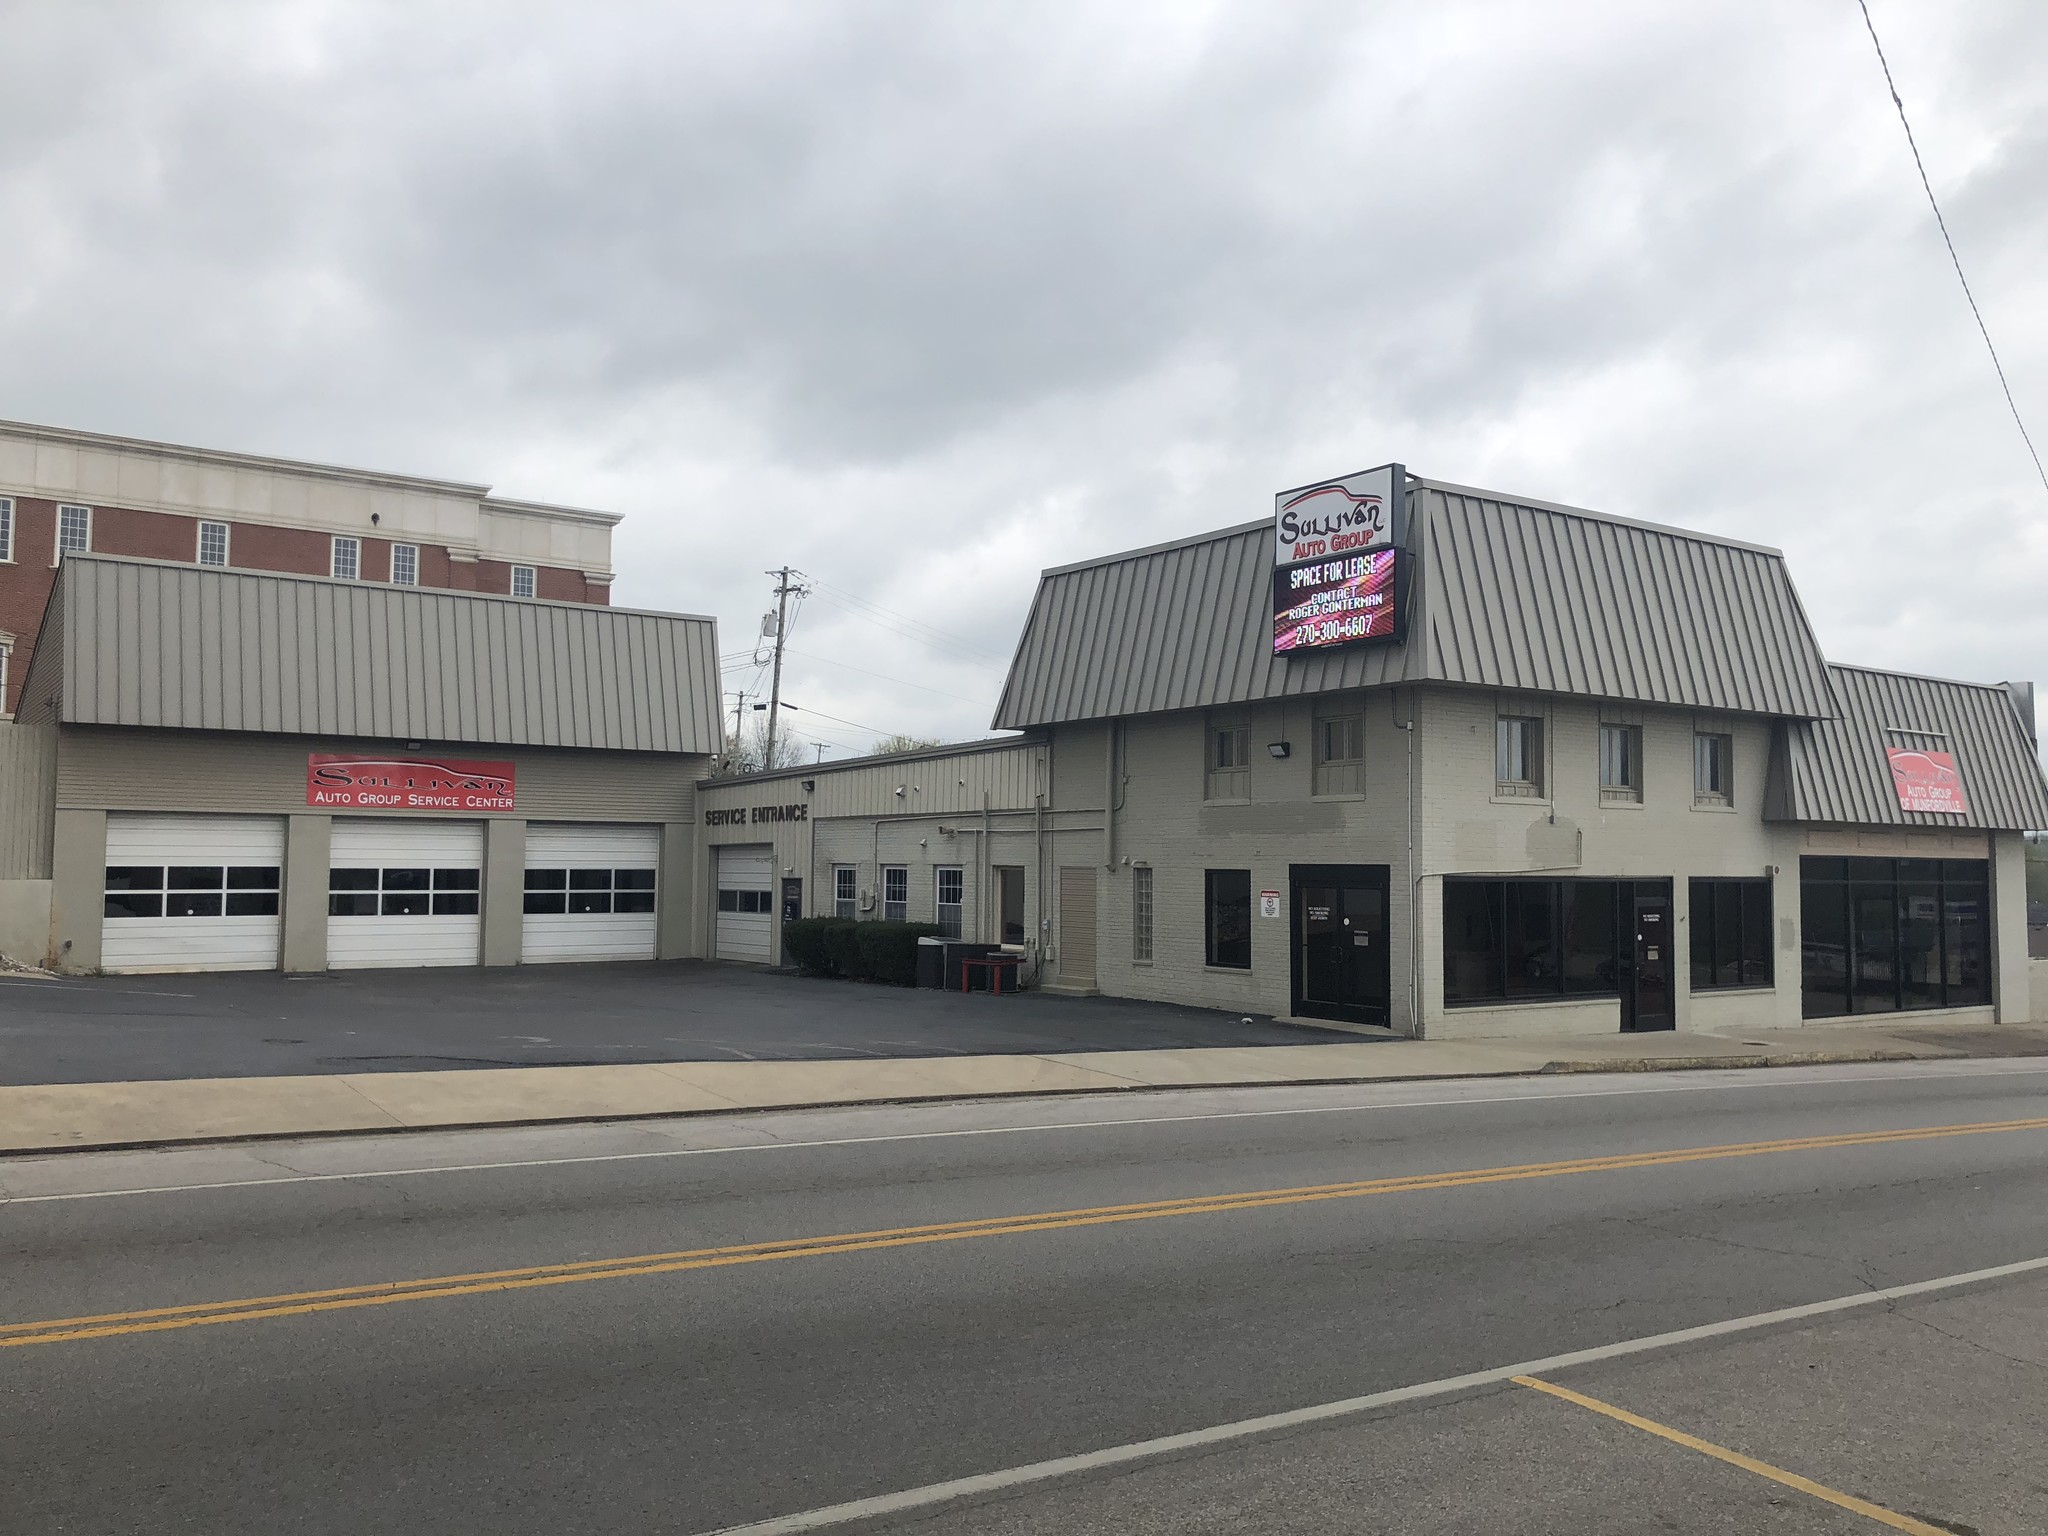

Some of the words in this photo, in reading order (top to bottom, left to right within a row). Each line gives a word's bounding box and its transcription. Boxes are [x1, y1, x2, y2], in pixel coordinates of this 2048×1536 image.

[1292, 539, 1326, 560] AUTO
[1330, 528, 1374, 552] GROUP
[1290, 564, 1322, 589] SPACE
[1323, 560, 1343, 583] FOR
[1345, 553, 1377, 579] LEASE
[1288, 604, 1319, 620] ROGER
[1322, 592, 1383, 614] GONTERMAN
[1311, 586, 1357, 605] CONTACT
[1295, 613, 1373, 645] 270-300-6607
[315, 790, 351, 803] AUTO
[358, 792, 402, 805] GROUP
[408, 793, 460, 807] SERVICE
[466, 795, 513, 808] CENTER
[1907, 784, 1927, 798] AUTO
[1928, 785, 1952, 799] GROUP
[705, 807, 747, 826] SERVICE
[752, 803, 808, 823] ENTRANCE
[1900, 797, 1911, 811] OF
[1911, 798, 1962, 812] MUNFORDVILLE
